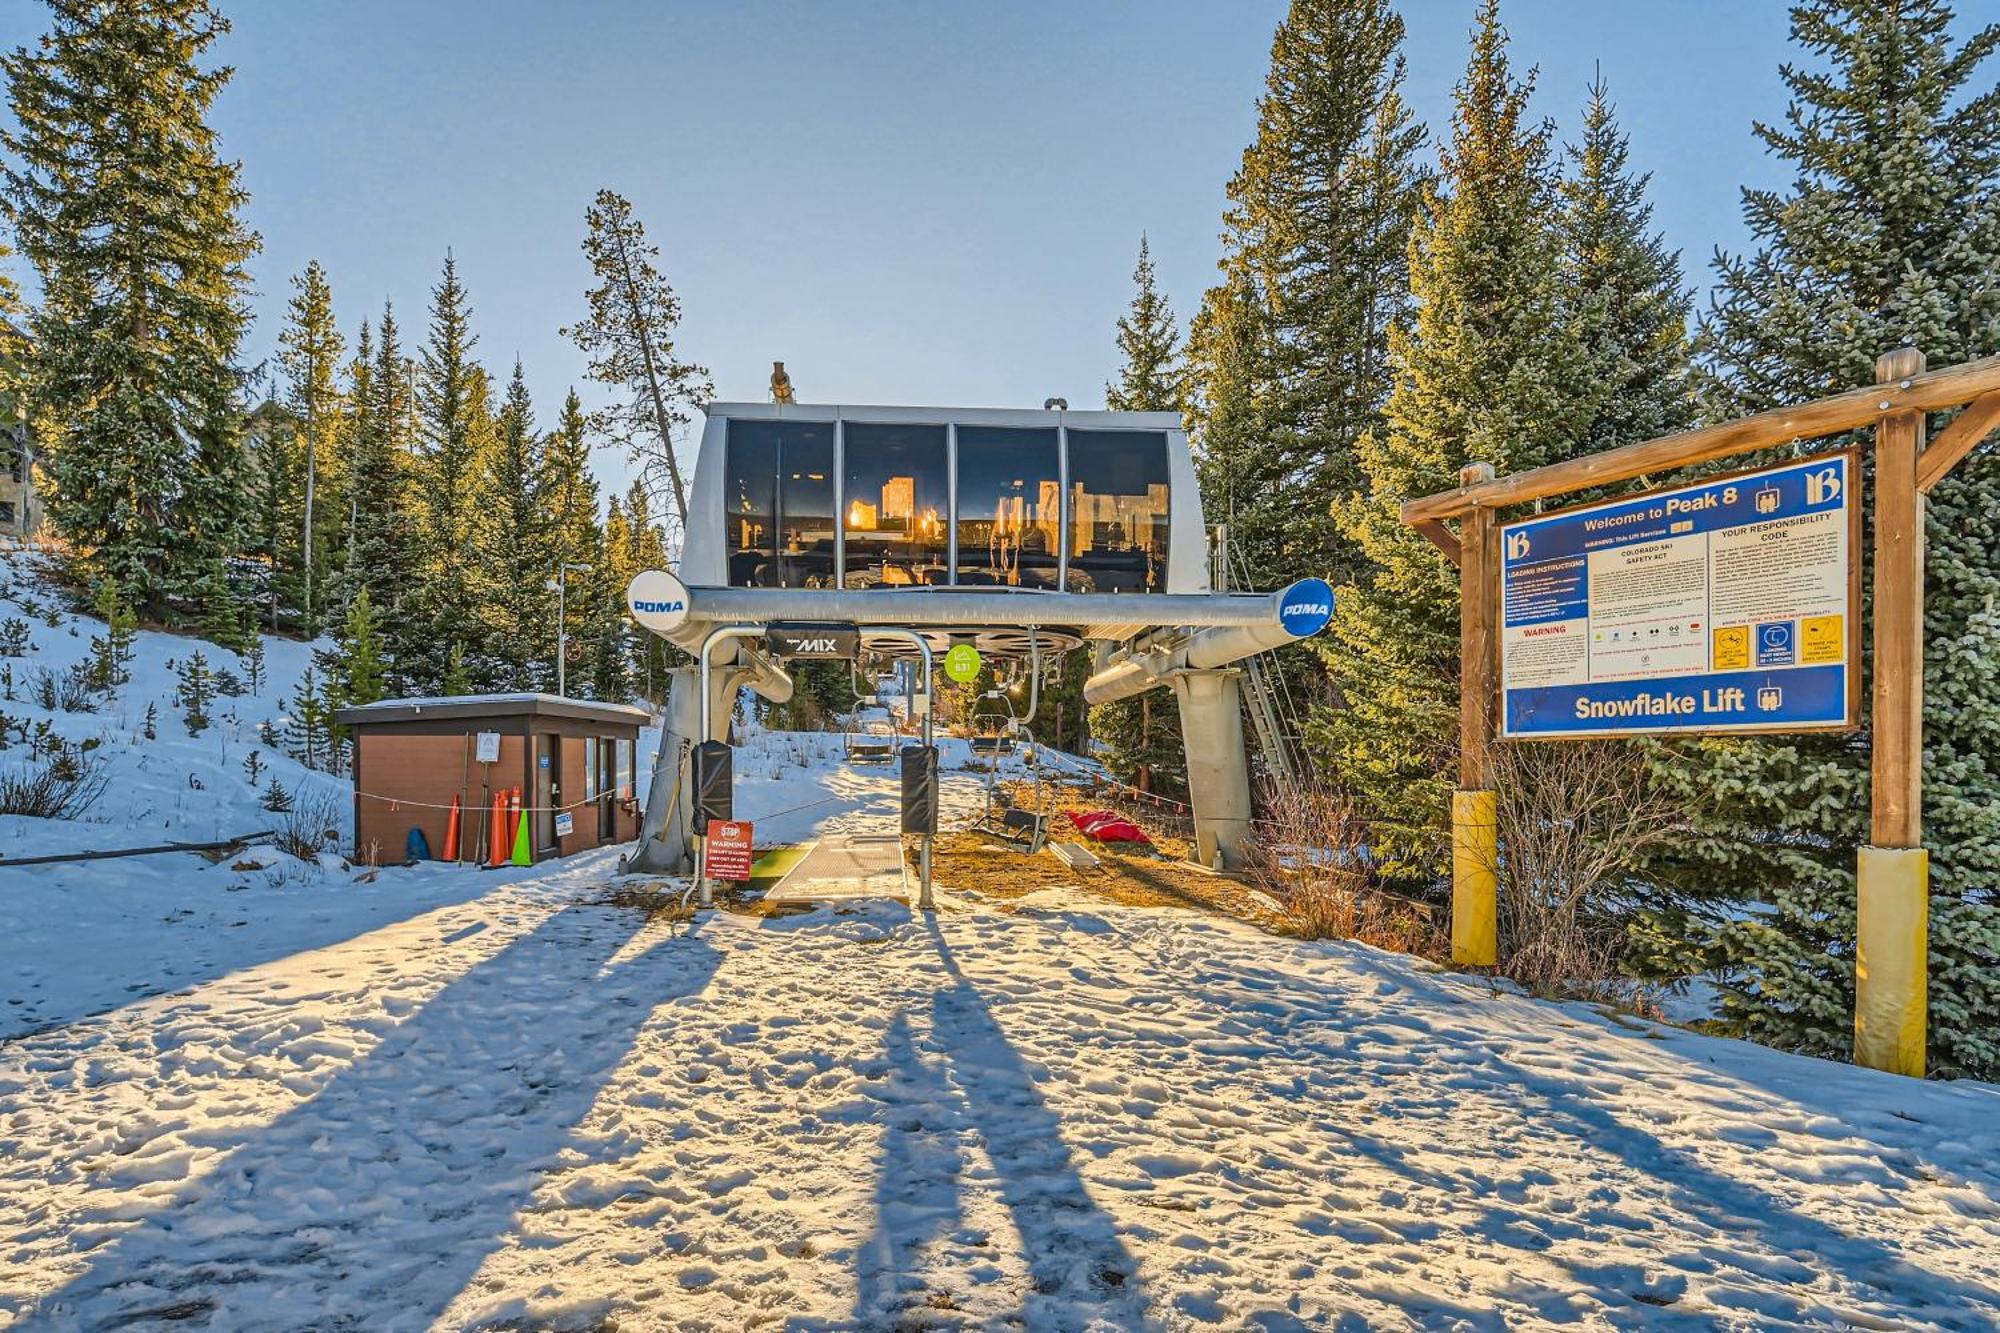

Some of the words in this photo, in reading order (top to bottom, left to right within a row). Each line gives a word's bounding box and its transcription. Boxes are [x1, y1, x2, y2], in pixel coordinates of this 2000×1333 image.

[1584, 512, 1645, 532] Welcome
[1649, 508, 1663, 520] to
[1666, 492, 1718, 517] Peak
[1722, 487, 1738, 505] 8
[1721, 525, 1748, 538] YOUR
[1750, 512, 1832, 533] RESPONSIBILITY
[1760, 530, 1789, 542] CODE
[1621, 545, 1659, 557] COLORADO
[1626, 555, 1653, 564] SAFETY
[1654, 552, 1668, 560] ACT
[1536, 560, 1585, 574] INSTRUCTIONS
[633, 600, 684, 613] POMA
[1283, 603, 1329, 617] POMA
[1523, 624, 1567, 637] WARNING
[1575, 692, 1696, 719] Snowflake
[1702, 687, 1745, 713] Lift
[711, 840, 748, 849] WARNING
